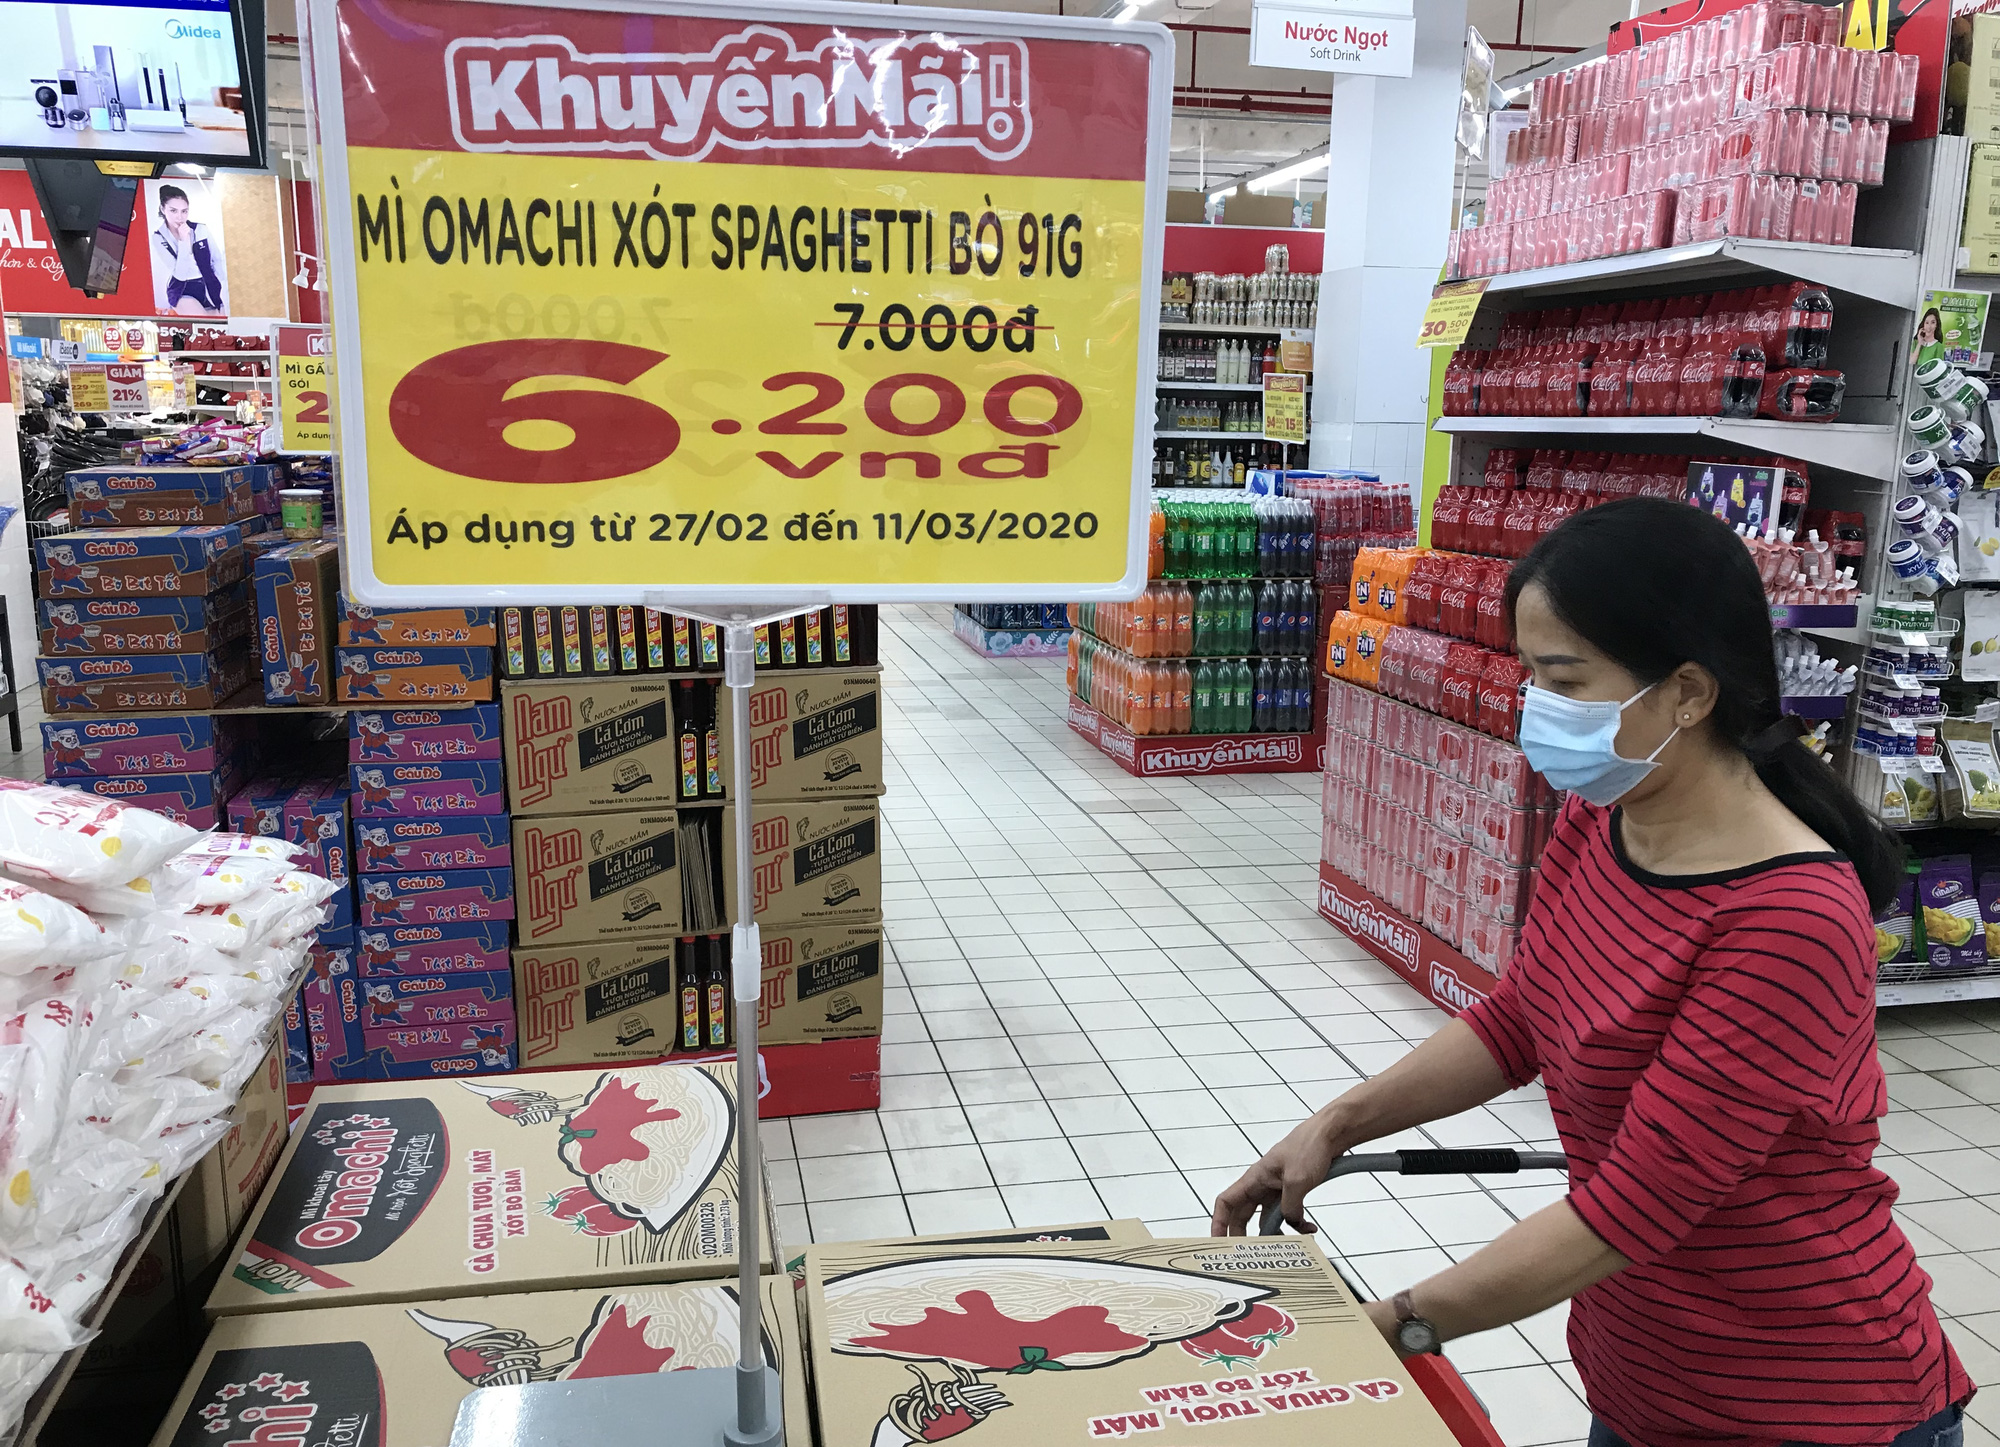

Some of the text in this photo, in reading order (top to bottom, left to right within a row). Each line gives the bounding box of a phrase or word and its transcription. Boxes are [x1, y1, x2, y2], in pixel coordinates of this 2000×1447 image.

[165, 18, 221, 39] Midea
[1285, 20, 1388, 51] Nước Ngọt
[1310, 47, 1361, 62] Soft Drink
[357, 175, 1082, 278] MÌ OMACHI XÓT SPAGHETTI BÒ 91G
[105, 330, 119, 341] 59
[129, 330, 142, 341] 39
[834, 303, 1039, 352] 7.000đ
[285, 362, 300, 374] MÌ
[289, 378, 309, 388] GÓI
[112, 389, 142, 401] 21%
[297, 431, 309, 439] Áp
[1285, 418, 1296, 430] 15
[756, 442, 1060, 479] vnđ
[387, 508, 1098, 549] Áp dụng từ 27/02 đến 11/03/2020
[513, 693, 572, 742] Nam
[808, 706, 856, 736] Cá Cơm
[594, 714, 644, 745] Cá Cơm
[524, 827, 582, 873] Nam
[469, 1150, 492, 1173] MÁT
[296, 1128, 398, 1250] Omachi
[300, 1170, 337, 1219] Mì khoai tây
[502, 1195, 523, 1211] BÒ
[473, 1213, 494, 1250] CHUA
[501, 1214, 525, 1237] XỐT
[468, 1252, 495, 1272] CÀ
[1193, 1253, 1206, 1261] kg
[1216, 1379, 1255, 1394] BÒ
[1259, 1371, 1314, 1391] XỐT
[1355, 1381, 1400, 1399] CÀ
[1262, 1385, 1351, 1411] CHUA
[1089, 1412, 1160, 1436] MÁT
